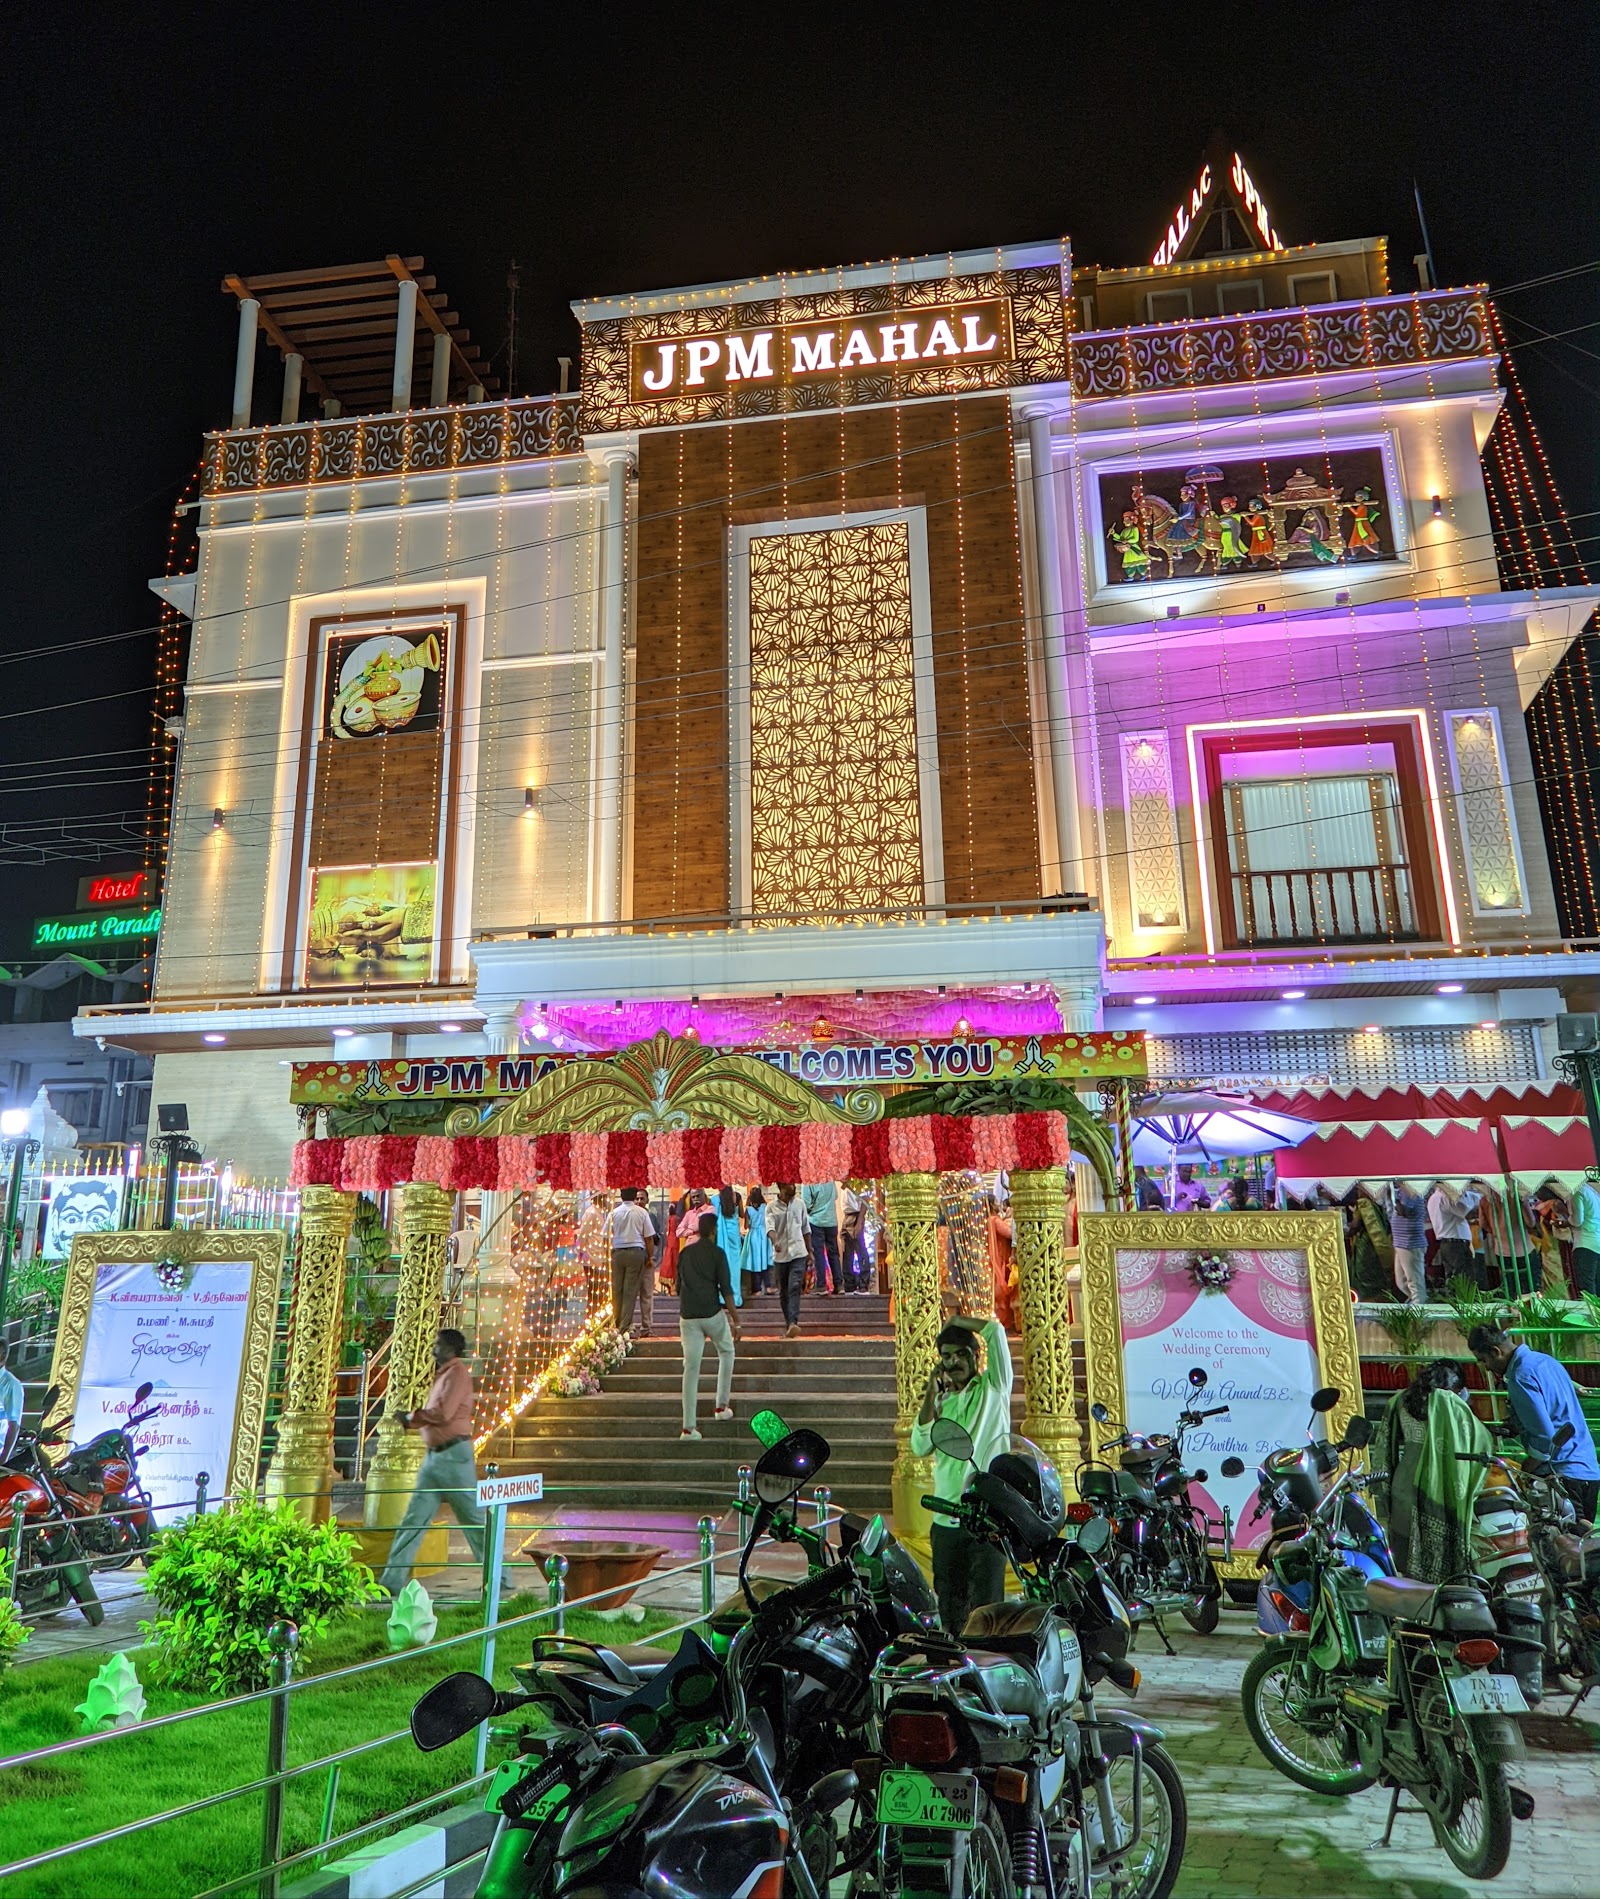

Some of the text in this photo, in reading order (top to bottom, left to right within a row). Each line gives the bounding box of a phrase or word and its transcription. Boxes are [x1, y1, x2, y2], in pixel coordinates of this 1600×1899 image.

[1231, 151, 1271, 249] JPM
[642, 314, 998, 391] JPM MAHAL
[91, 873, 143, 901] Hotel
[36, 908, 162, 944] Mount Paradi
[396, 1060, 486, 1096] JPM
[741, 1044, 918, 1082] ELCOMES
[923, 1043, 995, 1077] YOU
[1172, 1327, 1259, 1339] Welcome to the
[1162, 1343, 1271, 1358] Wedding Ceremony
[1212, 1358, 1224, 1369] of
[1219, 1380, 1262, 1400] Anand
[1214, 1413, 1232, 1423] weds
[497, 1479, 540, 1499] PARKING
[1452, 1602, 1474, 1610] TVS
[1364, 1640, 1386, 1648] TVS
[1470, 1678, 1502, 1691] TN 23
[930, 1786, 968, 1800] TN 23
[920, 1804, 971, 1824] AC 7906
